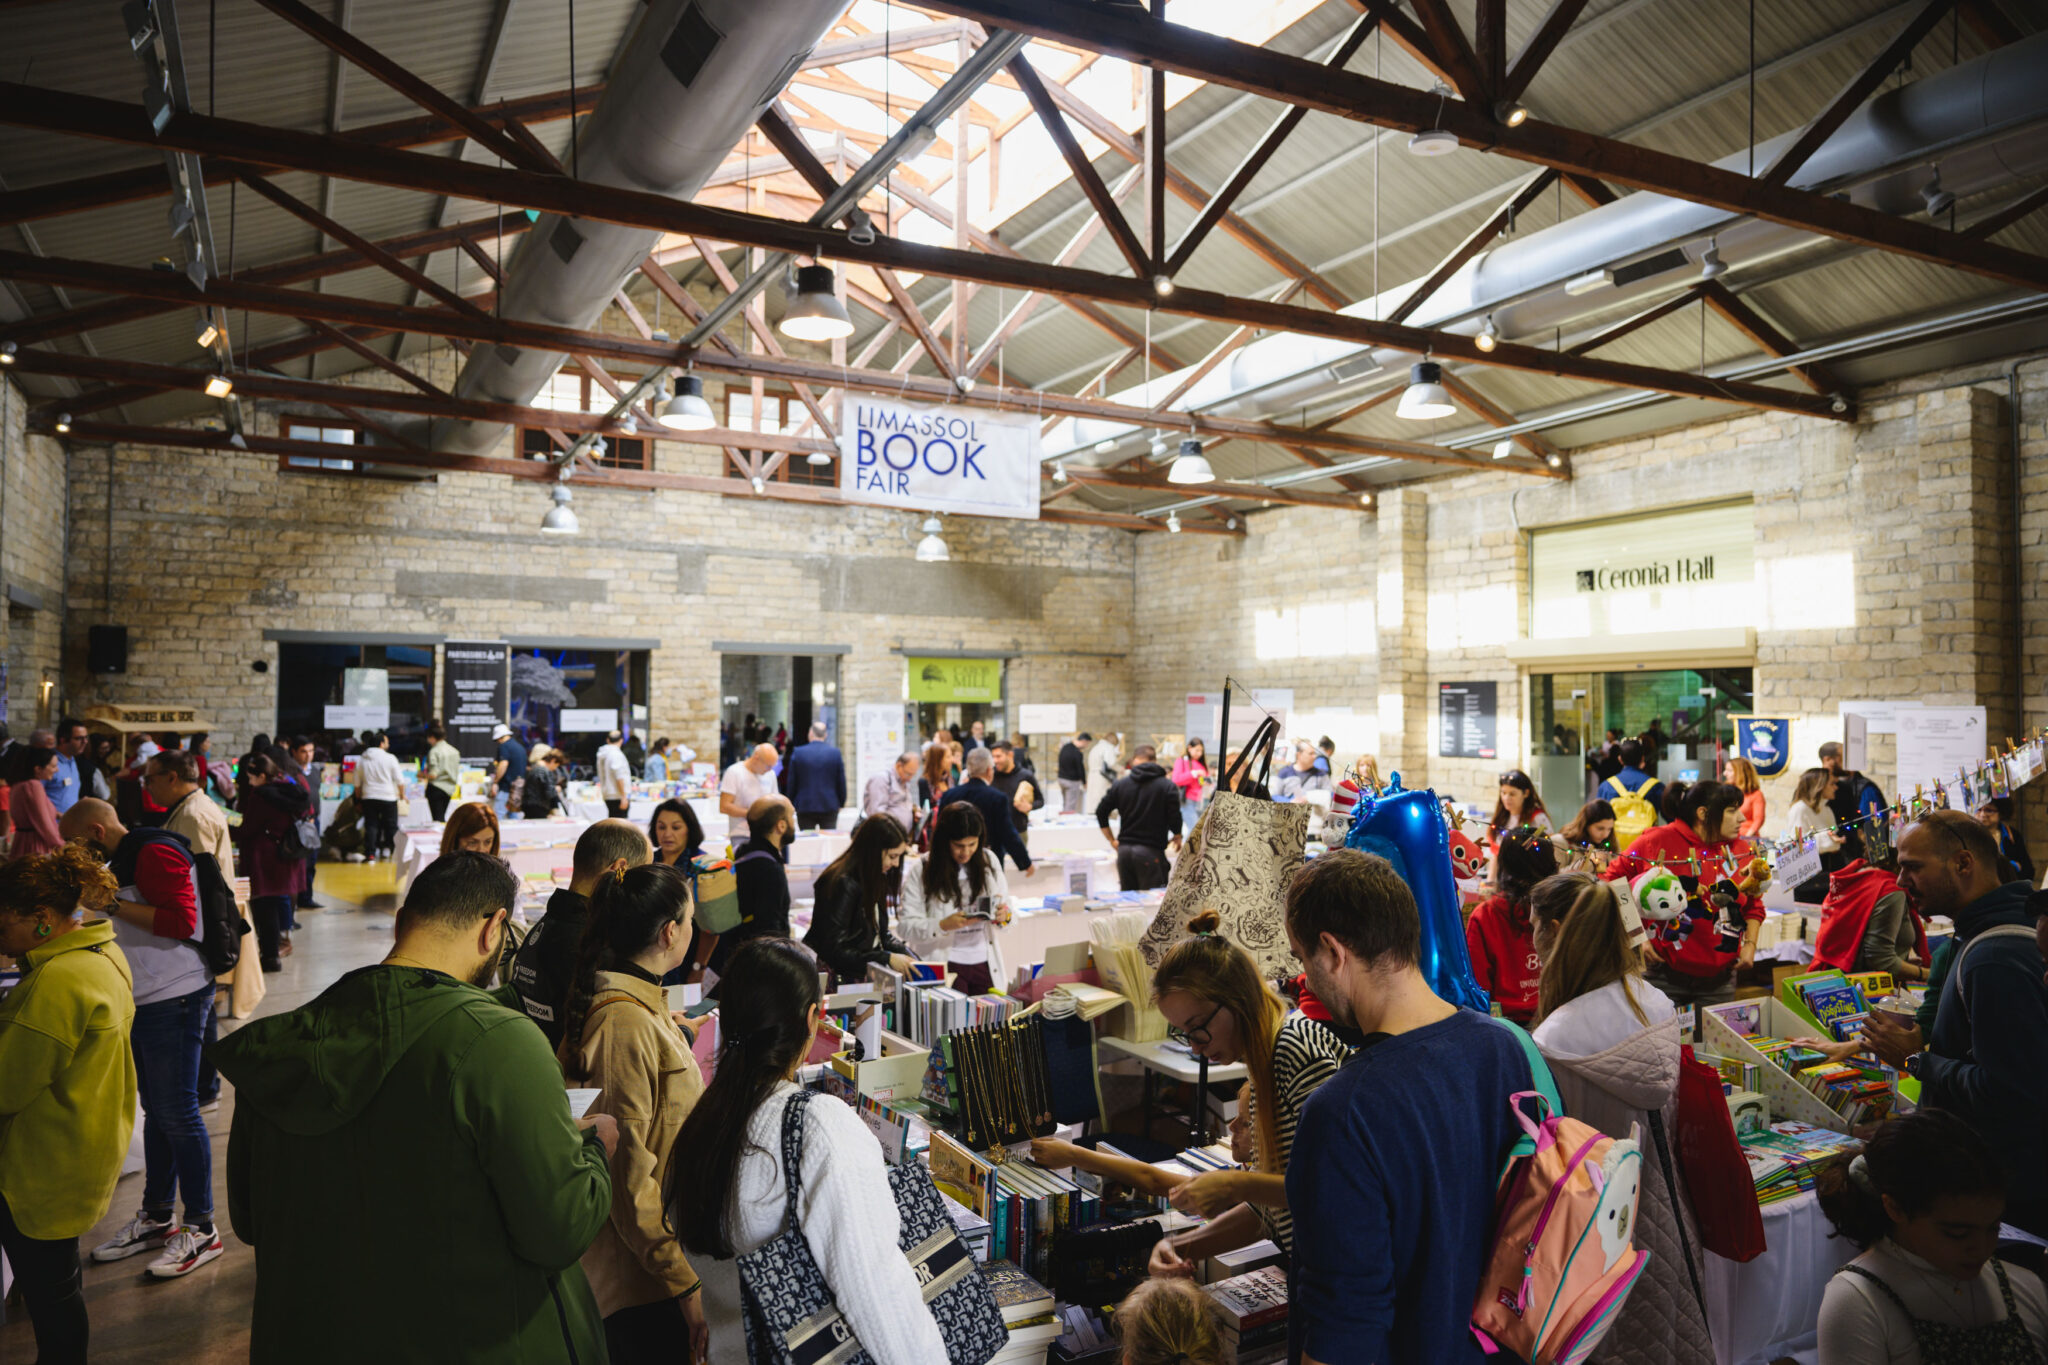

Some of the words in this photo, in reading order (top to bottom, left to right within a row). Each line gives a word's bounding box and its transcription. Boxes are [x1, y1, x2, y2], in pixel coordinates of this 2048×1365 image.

[857, 405, 978, 442] LIMASSOL
[857, 428, 987, 480] BOOK
[856, 467, 911, 495] FAIR
[1598, 562, 1669, 591] Ceronia
[1677, 555, 1714, 582] Hall
[526, 1002, 549, 1017] FREEDOM
